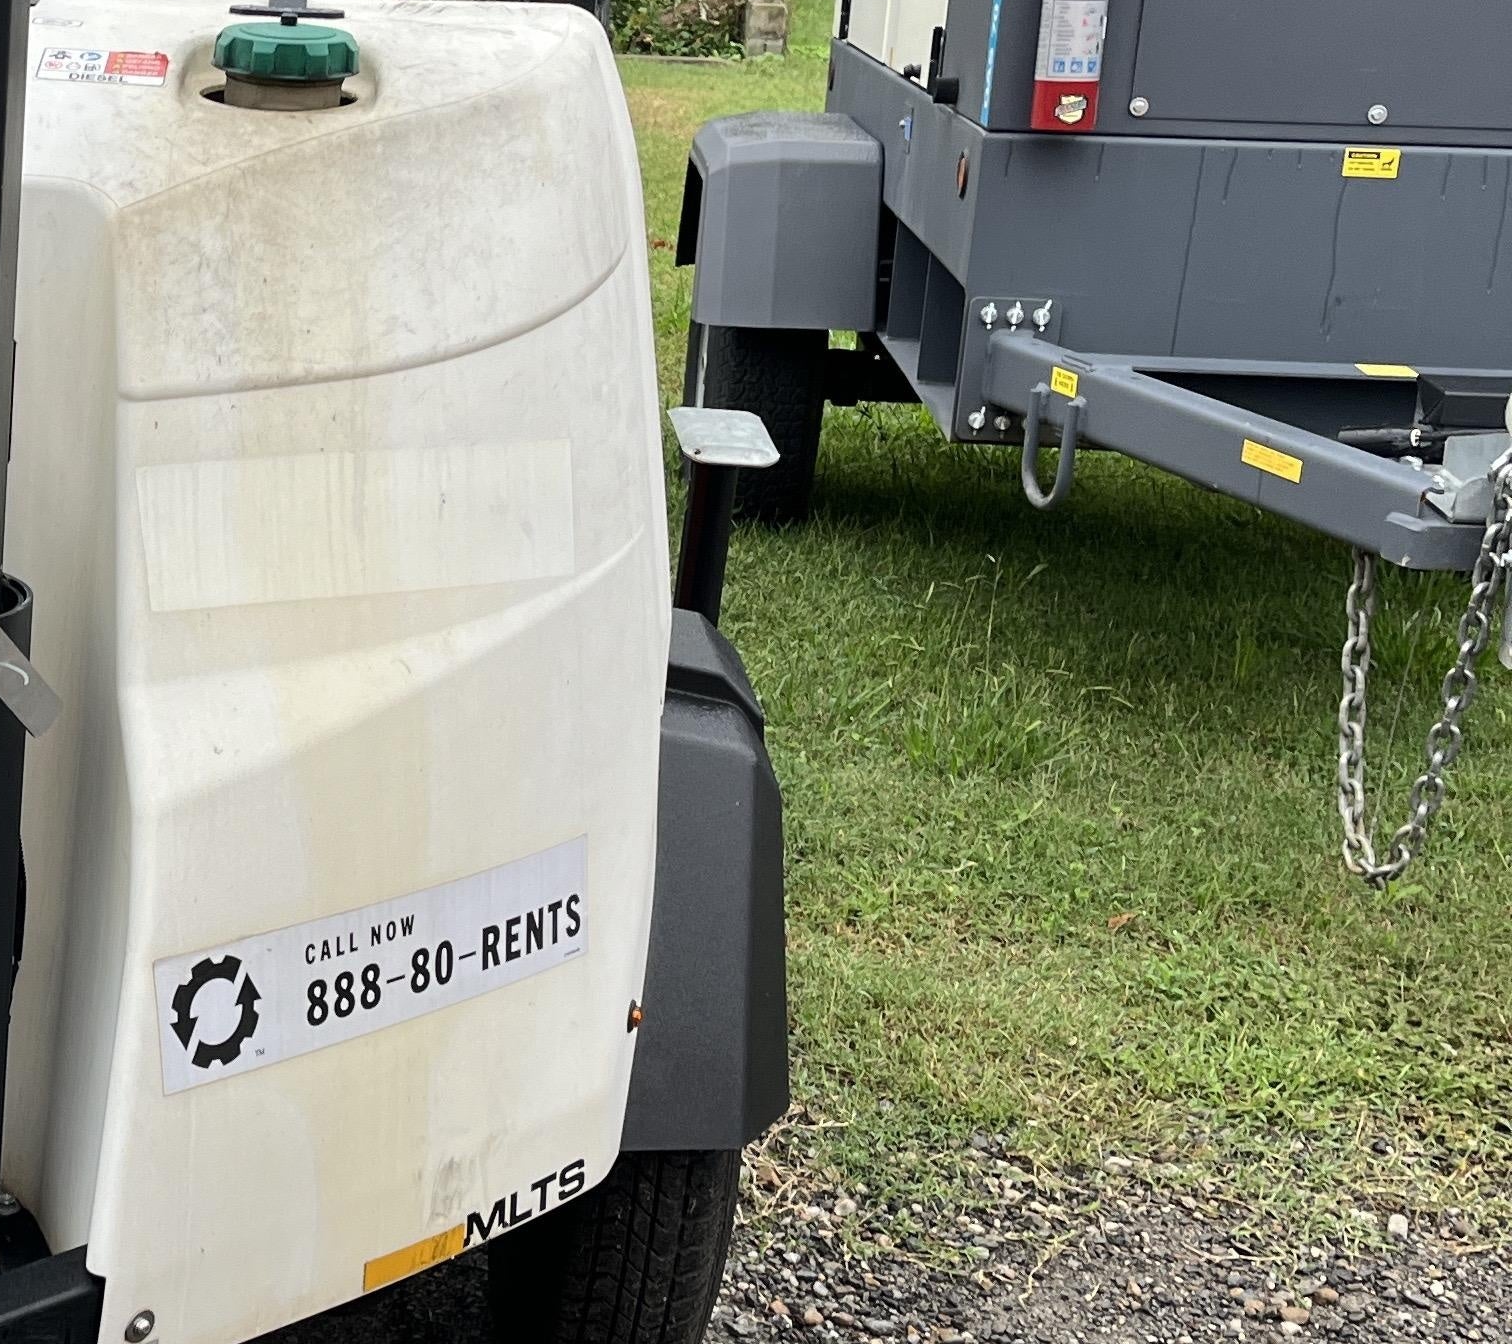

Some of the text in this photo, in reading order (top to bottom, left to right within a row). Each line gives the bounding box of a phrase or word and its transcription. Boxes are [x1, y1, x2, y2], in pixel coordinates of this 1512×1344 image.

[68, 72, 130, 84] DIESEL
[305, 913, 416, 965] CALL NOW
[306, 892, 582, 1027] 888-80-RENTS
[462, 1158, 585, 1249] MLTS
